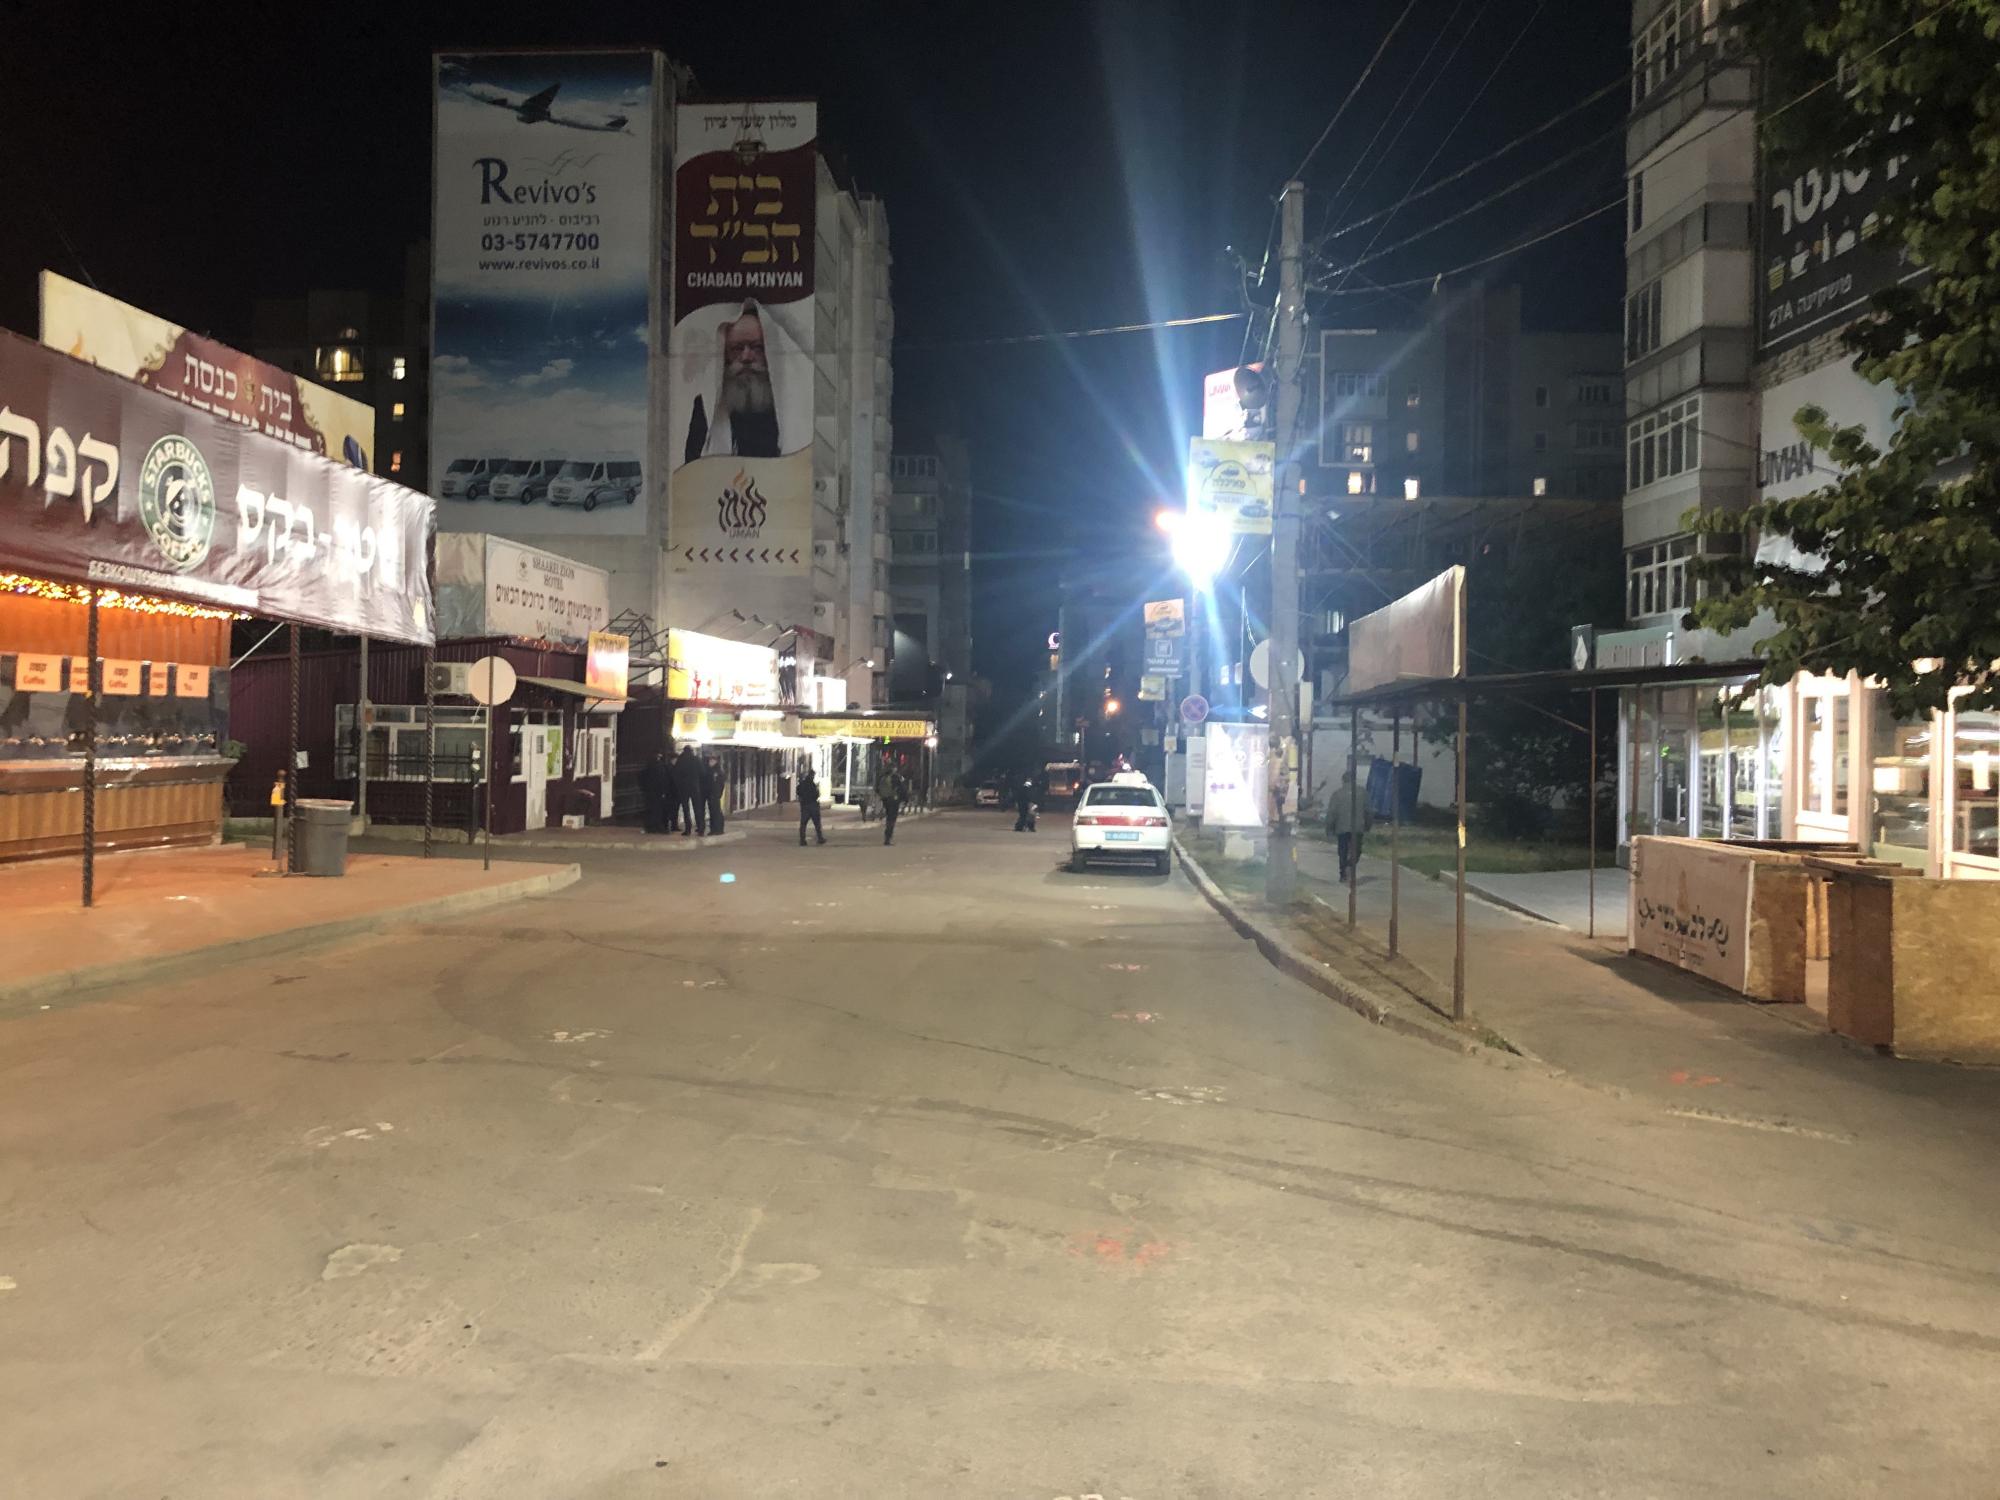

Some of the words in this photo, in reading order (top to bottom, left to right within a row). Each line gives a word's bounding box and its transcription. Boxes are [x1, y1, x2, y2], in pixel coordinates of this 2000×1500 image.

[471, 157, 597, 205] Revivo's
[706, 174, 784, 216] בית
[481, 232, 600, 251] 03-5747700
[478, 257, 600, 271] www.revivos.co.il
[687, 272, 742, 288] CHABAD
[746, 271, 803, 288] MINYAN
[183, 352, 239, 400] כנסת
[260, 383, 292, 422] בית
[0, 405, 119, 524] קפה
[144, 440, 211, 503] STARBUCKS
[852, 720, 894, 729] SHAAREI
[897, 720, 922, 729] ZION
